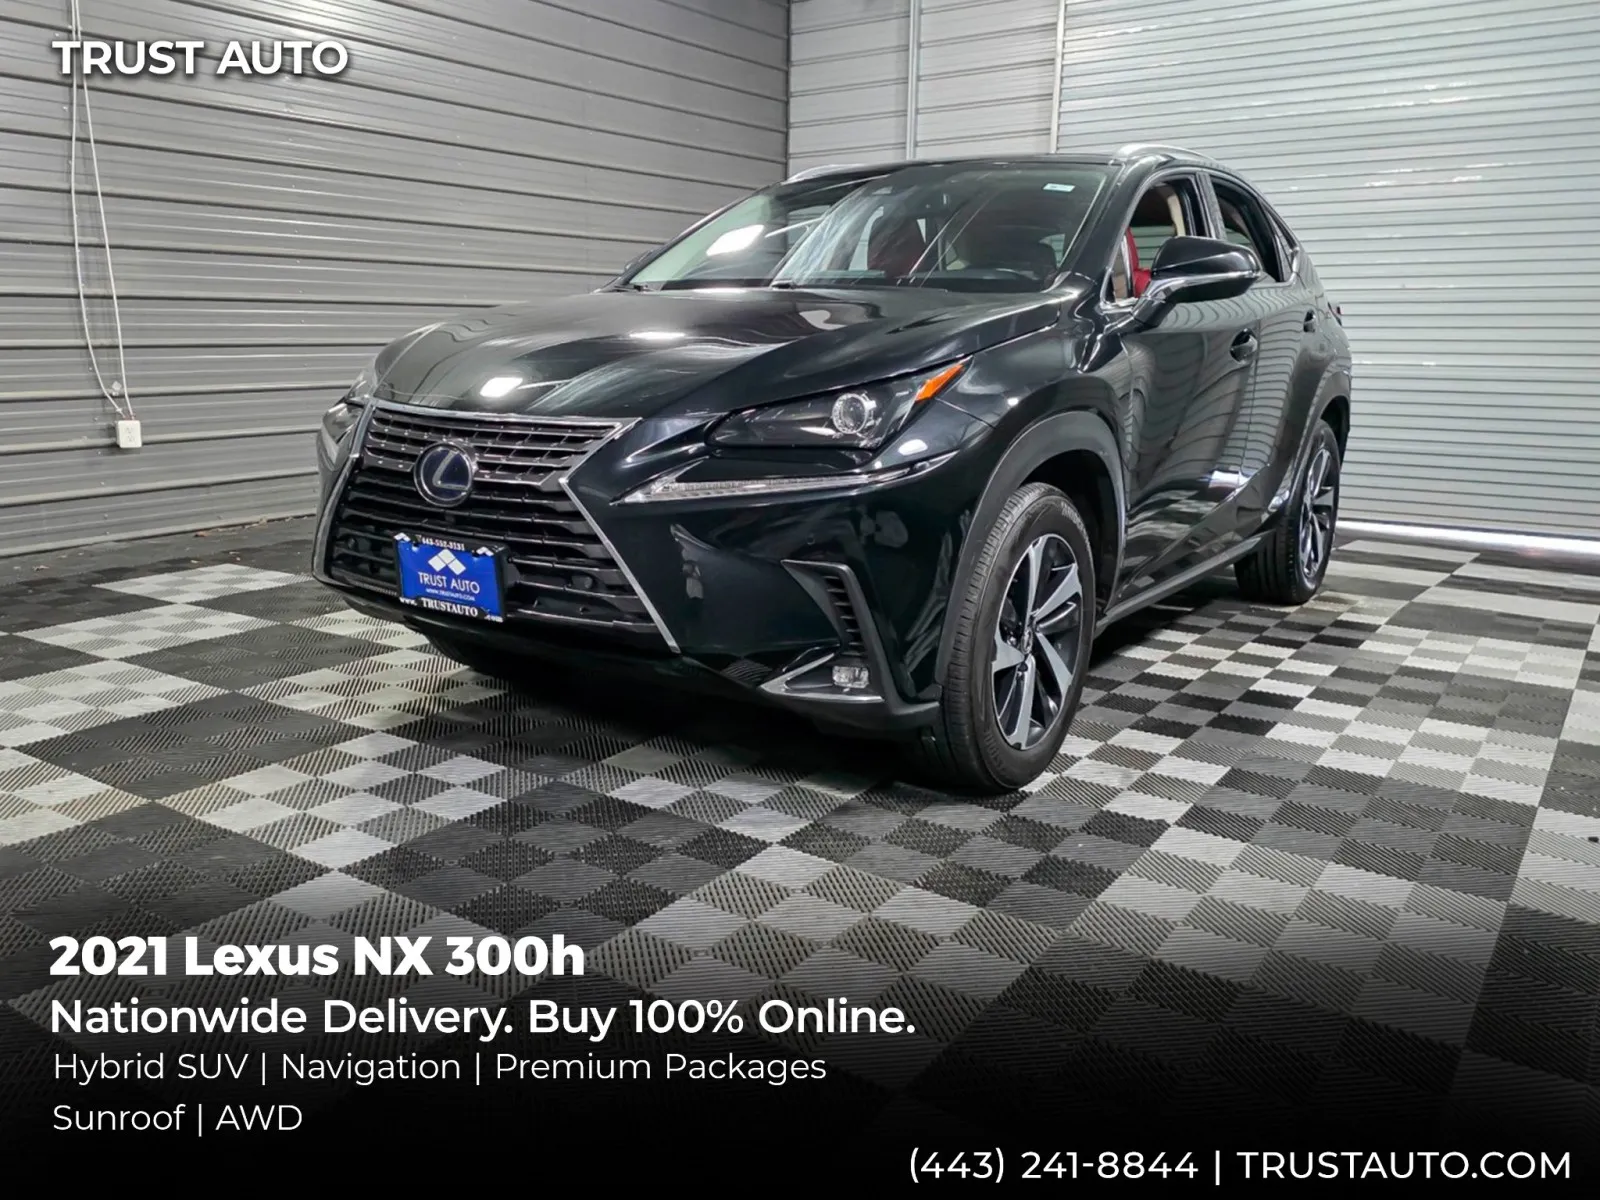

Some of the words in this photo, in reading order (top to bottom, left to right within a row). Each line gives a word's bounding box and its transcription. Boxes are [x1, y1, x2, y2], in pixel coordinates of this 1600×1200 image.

[417, 571, 447, 588] TRUST
[450, 579, 480, 594] AUTO
[421, 597, 478, 617] TRUSTAUTO
